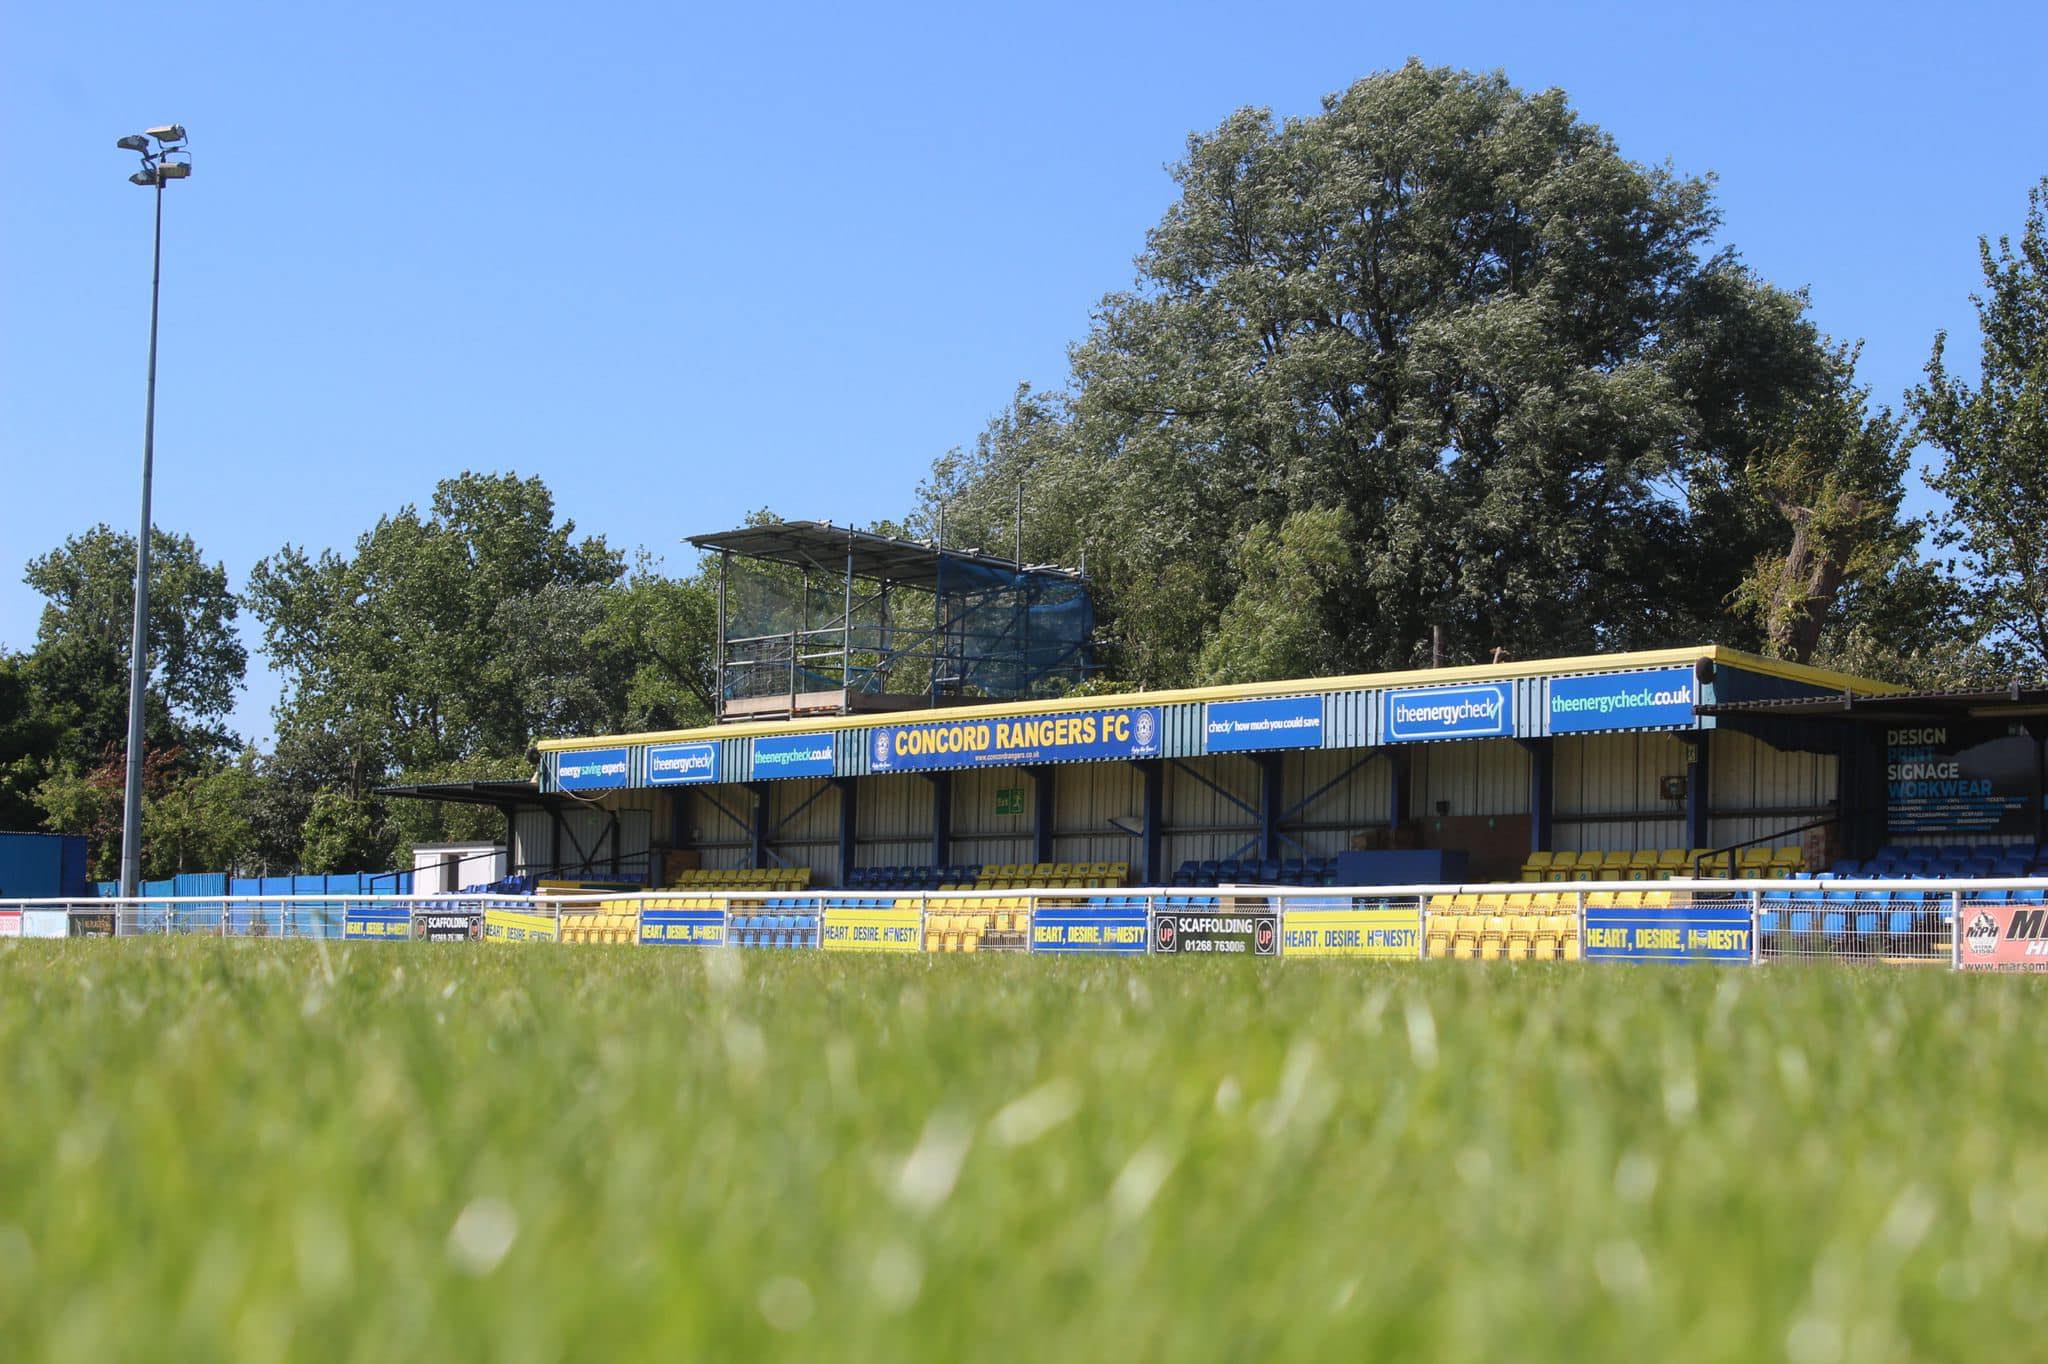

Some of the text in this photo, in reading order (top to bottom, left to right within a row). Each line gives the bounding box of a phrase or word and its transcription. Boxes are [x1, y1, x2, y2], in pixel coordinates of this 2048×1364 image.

[1552, 685, 1691, 713] theenergycheck.co.uk
[1396, 697, 1494, 725] theenergycheck
[1234, 720, 1250, 732] how
[1250, 718, 1270, 731] much
[1270, 720, 1283, 732] you
[1284, 716, 1303, 729] could
[1304, 717, 1320, 728] save
[895, 724, 990, 756] CONCORD
[996, 716, 1097, 750] RANGERS
[1102, 714, 1130, 743] FC
[1887, 727, 1946, 746] DESIGN
[653, 753, 708, 773] theenergycheck
[755, 746, 832, 765] theenergycheck.co.uk
[560, 761, 625, 779] energy saving experts
[1887, 763, 1960, 780] SIGNAGE
[1888, 779, 1993, 798] WORKWEAR
[429, 917, 469, 929] SCAFFOLDING
[1179, 917, 1253, 934] SCAFFOLDING
[1966, 926, 1999, 938] MPH
[1034, 926, 1066, 945] HEART,
[1067, 926, 1102, 945] DESIRE,
[1160, 928, 1173, 942] UP
[1258, 930, 1272, 945] UP
[1284, 930, 1321, 949] HEART,
[1324, 929, 1364, 949] DESIRE,
[1587, 928, 1633, 951] HEART,
[1635, 928, 1686, 952] DESIRE,
[1184, 940, 1246, 953] 01268 763006
